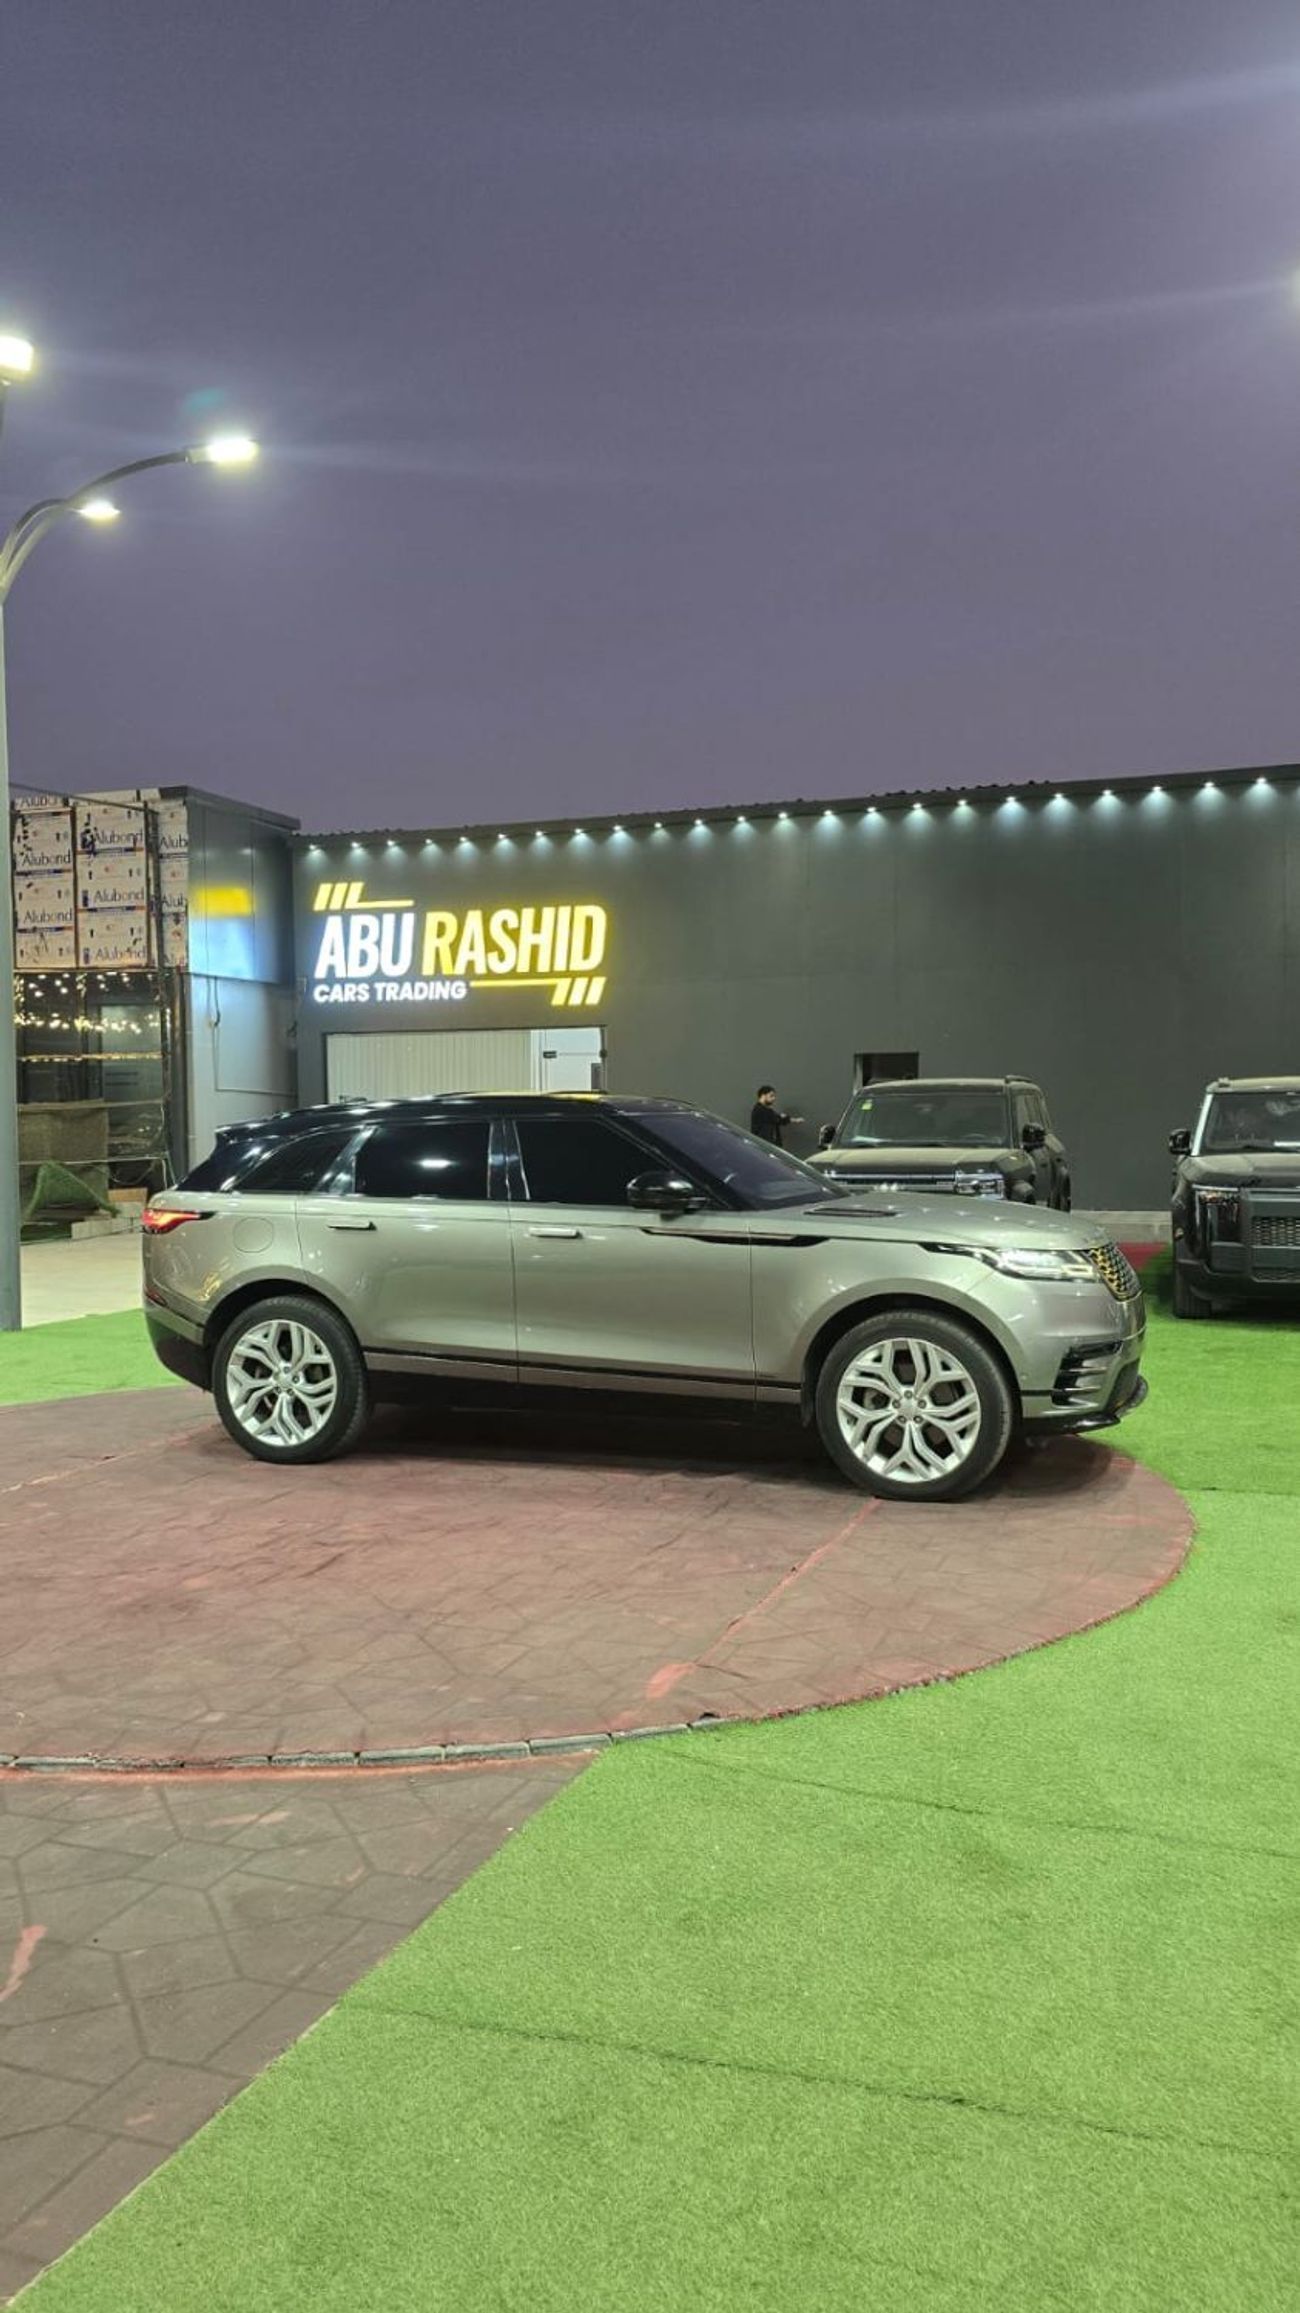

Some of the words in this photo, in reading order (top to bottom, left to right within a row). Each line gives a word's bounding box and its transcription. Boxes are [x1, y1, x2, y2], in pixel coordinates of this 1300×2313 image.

[22, 849, 71, 866] Alubond
[94, 886, 144, 902] Alubond
[24, 909, 72, 924] Alubond
[314, 913, 414, 979] ABU
[422, 905, 607, 976] RASHID
[314, 984, 369, 1003] CARS
[375, 981, 467, 1001] TRADING
